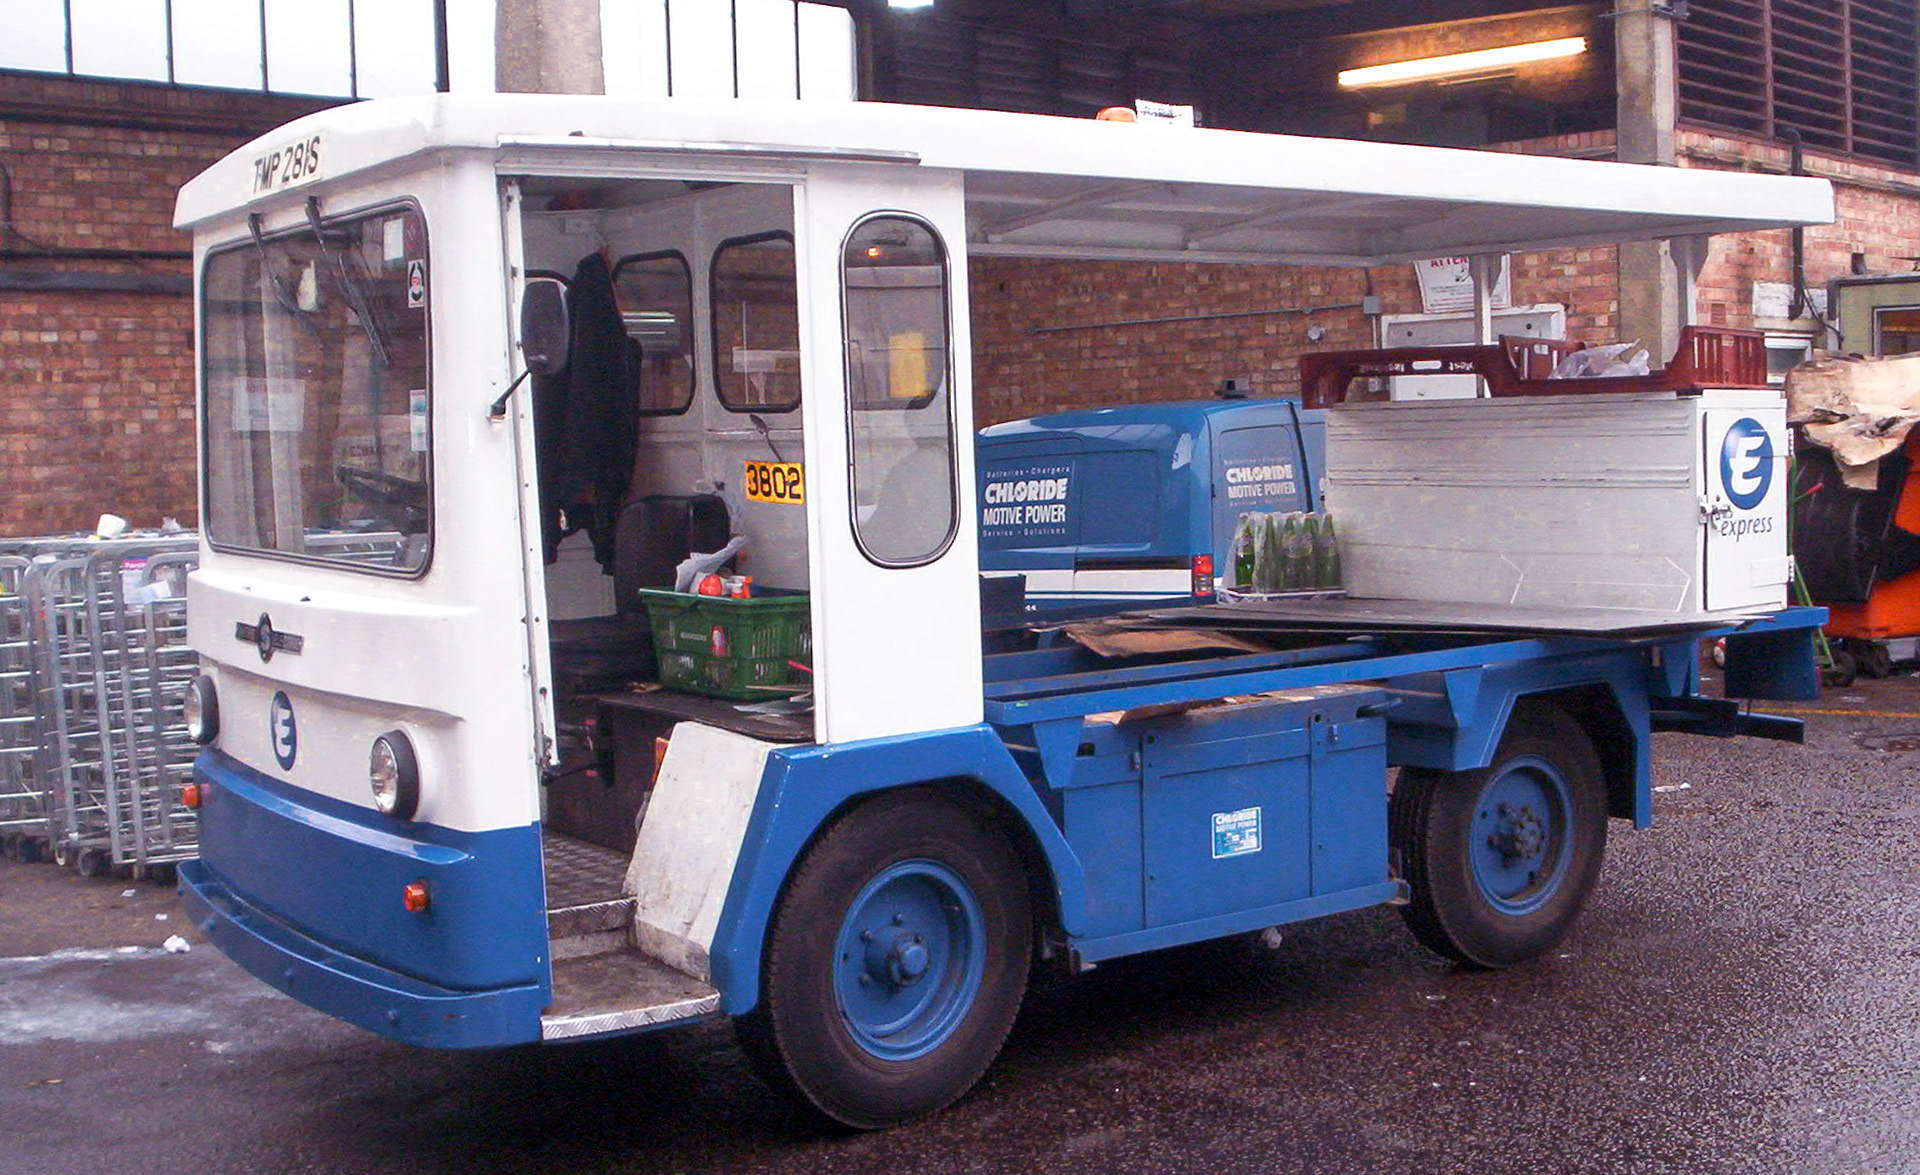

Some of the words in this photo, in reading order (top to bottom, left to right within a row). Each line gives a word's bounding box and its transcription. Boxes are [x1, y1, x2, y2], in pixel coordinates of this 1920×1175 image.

[253, 152, 281, 194] TMP
[282, 135, 321, 183] 281S
[746, 464, 802, 499] 3802
[1226, 464, 1293, 483] CHLORIDE
[984, 478, 1069, 504] CHLORIDE
[1228, 484, 1263, 499] MOTIVE
[1264, 481, 1296, 496] POWER
[983, 506, 1023, 526] MOTIVE
[1024, 504, 1066, 524] POWER
[1721, 517, 1773, 543] express
